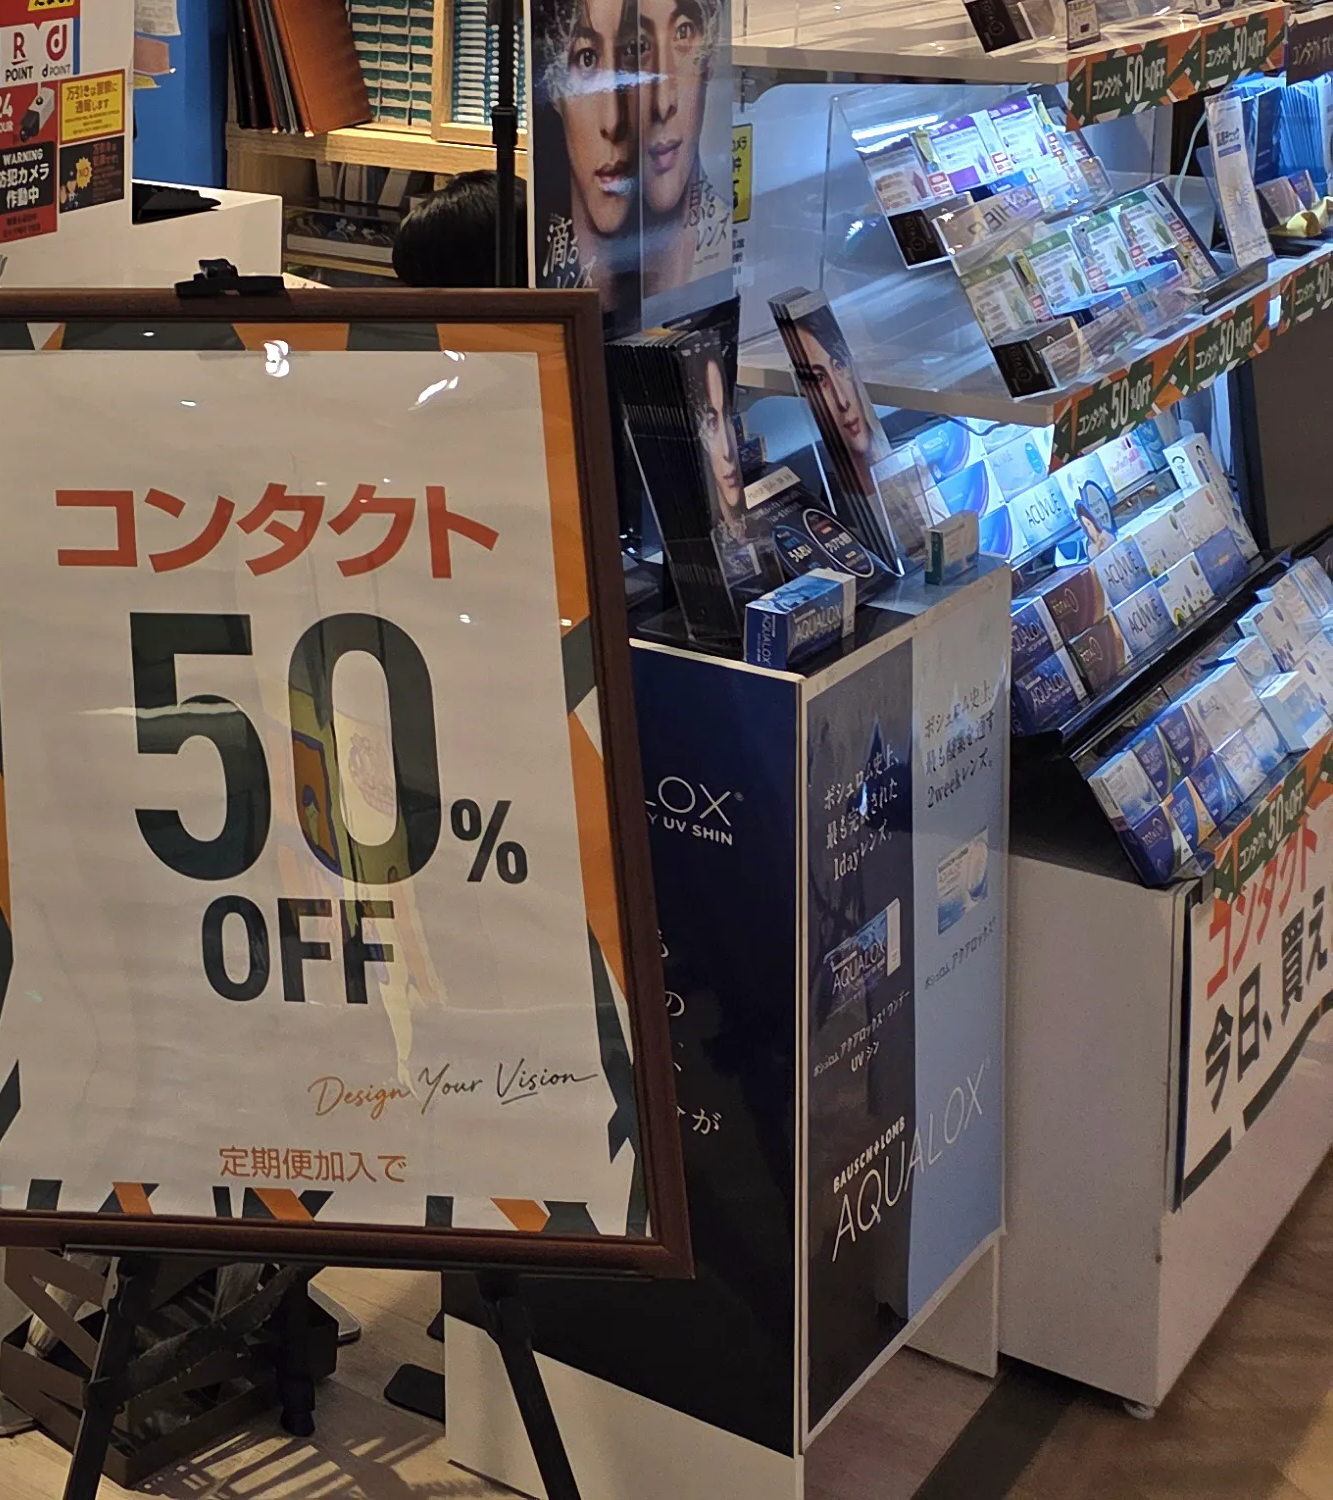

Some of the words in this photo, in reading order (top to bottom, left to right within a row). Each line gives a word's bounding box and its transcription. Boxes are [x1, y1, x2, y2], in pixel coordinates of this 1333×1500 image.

[5, 66, 33, 82] POINT
[49, 64, 71, 77] POINT
[1093, 80, 1123, 100] コンタクト
[1125, 56, 1166, 104] 50%OFF
[3, 148, 44, 166] WARNING
[6, 187, 40, 209] 作動中
[55, 483, 498, 579] コンタクト
[129, 611, 528, 886] 50%
[663, 816, 687, 833] UV
[693, 824, 733, 846] SHIN
[201, 896, 395, 1005] OFF
[851, 1051, 865, 1072] UV
[307, 1076, 413, 1120] Design
[418, 1063, 483, 1115] Your
[497, 1058, 599, 1105] Vision
[219, 1146, 407, 1184] 定期便加入で
[832, 1061, 984, 1262] AQUALOX
